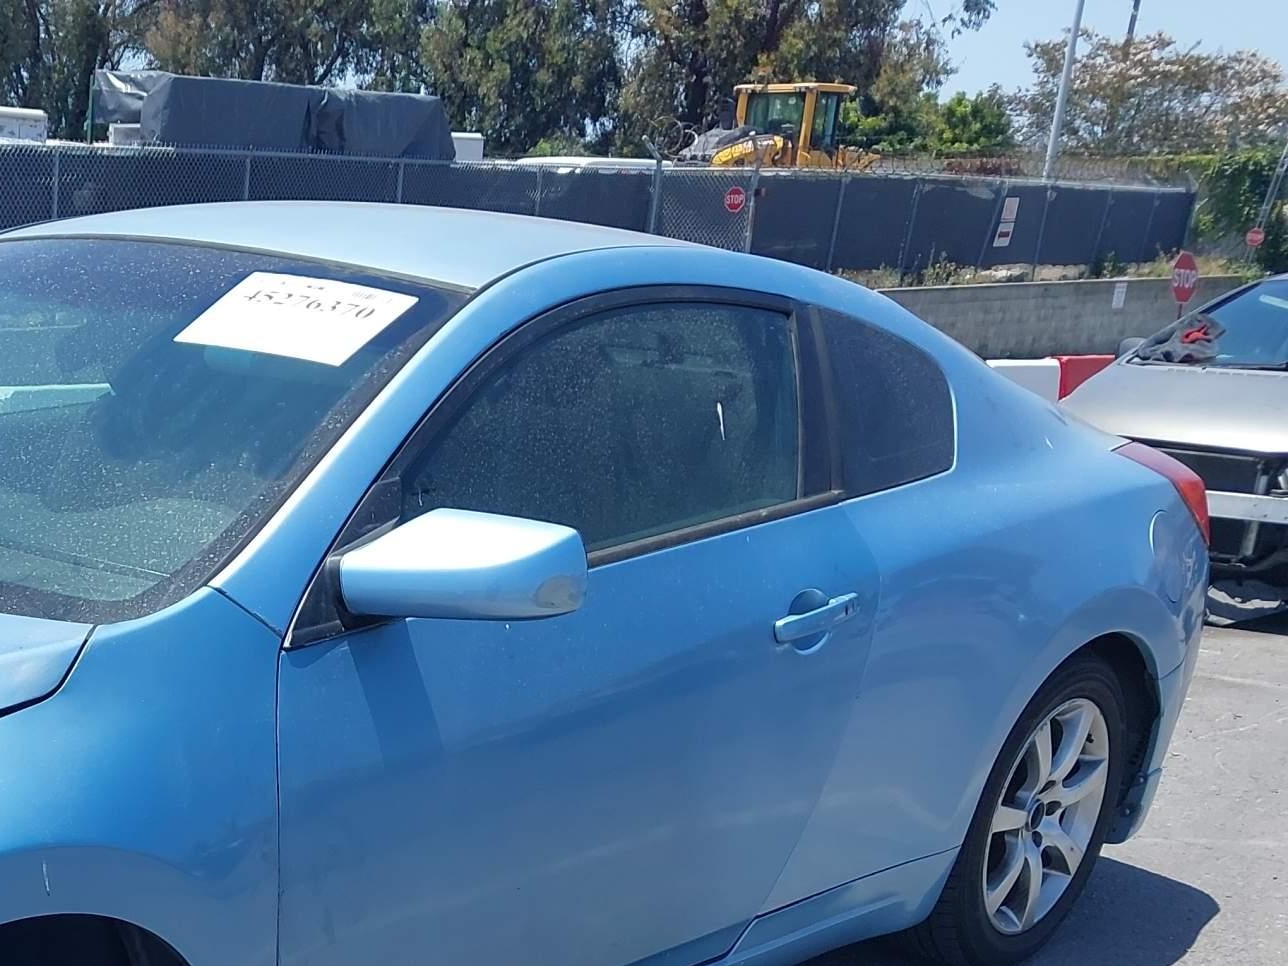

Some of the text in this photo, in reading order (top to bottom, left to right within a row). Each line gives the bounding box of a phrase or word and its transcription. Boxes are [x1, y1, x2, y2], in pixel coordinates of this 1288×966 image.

[726, 194, 744, 205] STOP
[1173, 268, 1197, 289] STOP
[242, 289, 376, 319] 45276370
